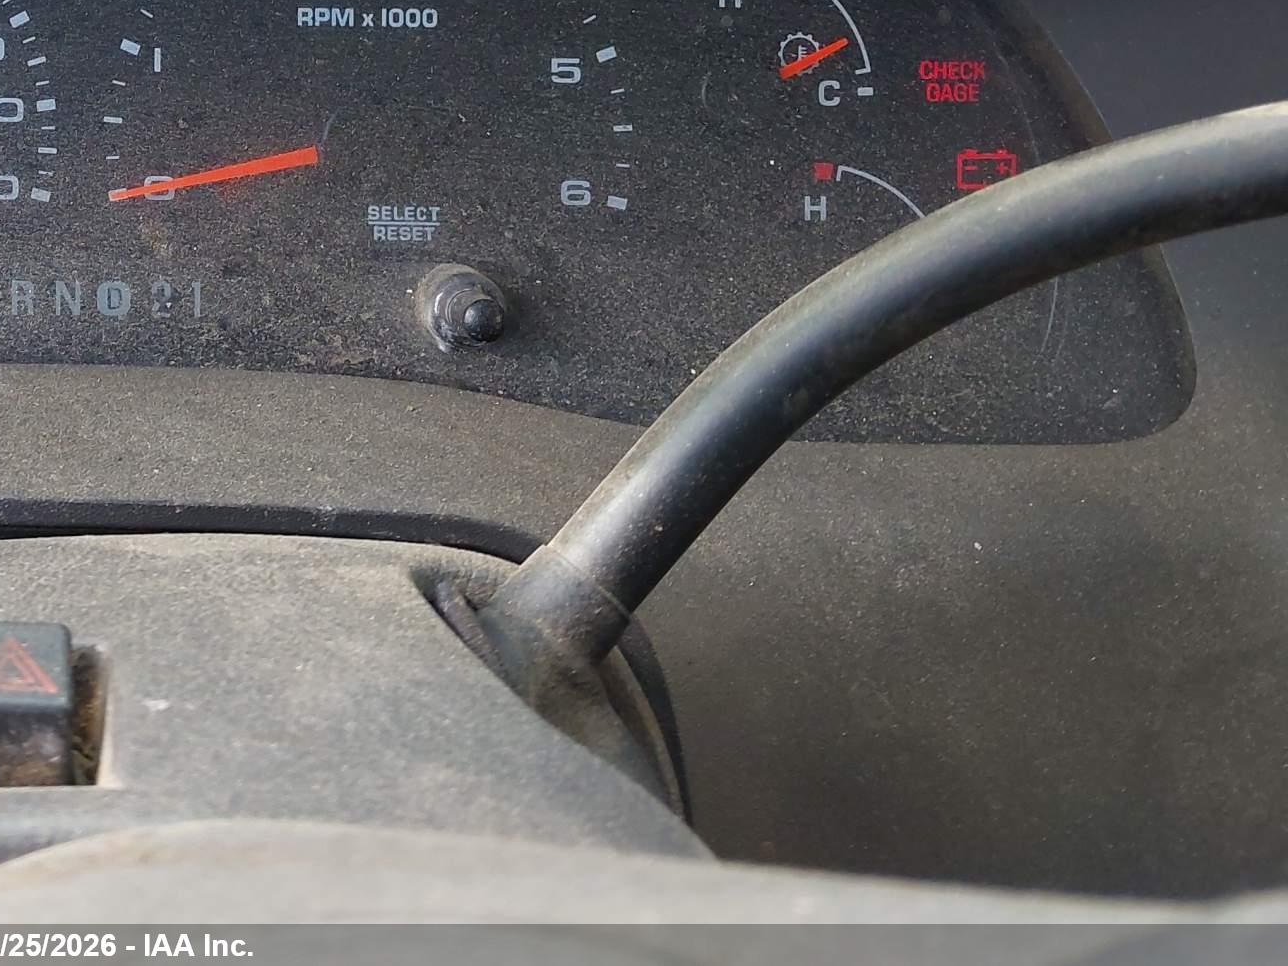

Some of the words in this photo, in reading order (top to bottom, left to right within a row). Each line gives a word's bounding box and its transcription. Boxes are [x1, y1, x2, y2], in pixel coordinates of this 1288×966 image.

[297, 8, 355, 27] RPM
[361, 13, 374, 27] x
[381, 8, 438, 28] 1000
[551, 57, 581, 84] 5
[919, 60, 985, 80] CHECK
[817, 80, 841, 106] C
[926, 83, 980, 102] GAGE
[143, 175, 175, 201] 0
[560, 180, 591, 206] 6
[367, 205, 440, 221] SELECT
[804, 195, 827, 221] H
[373, 225, 436, 241] RESET
[11, 280, 35, 315] R
[54, 280, 81, 316] N
